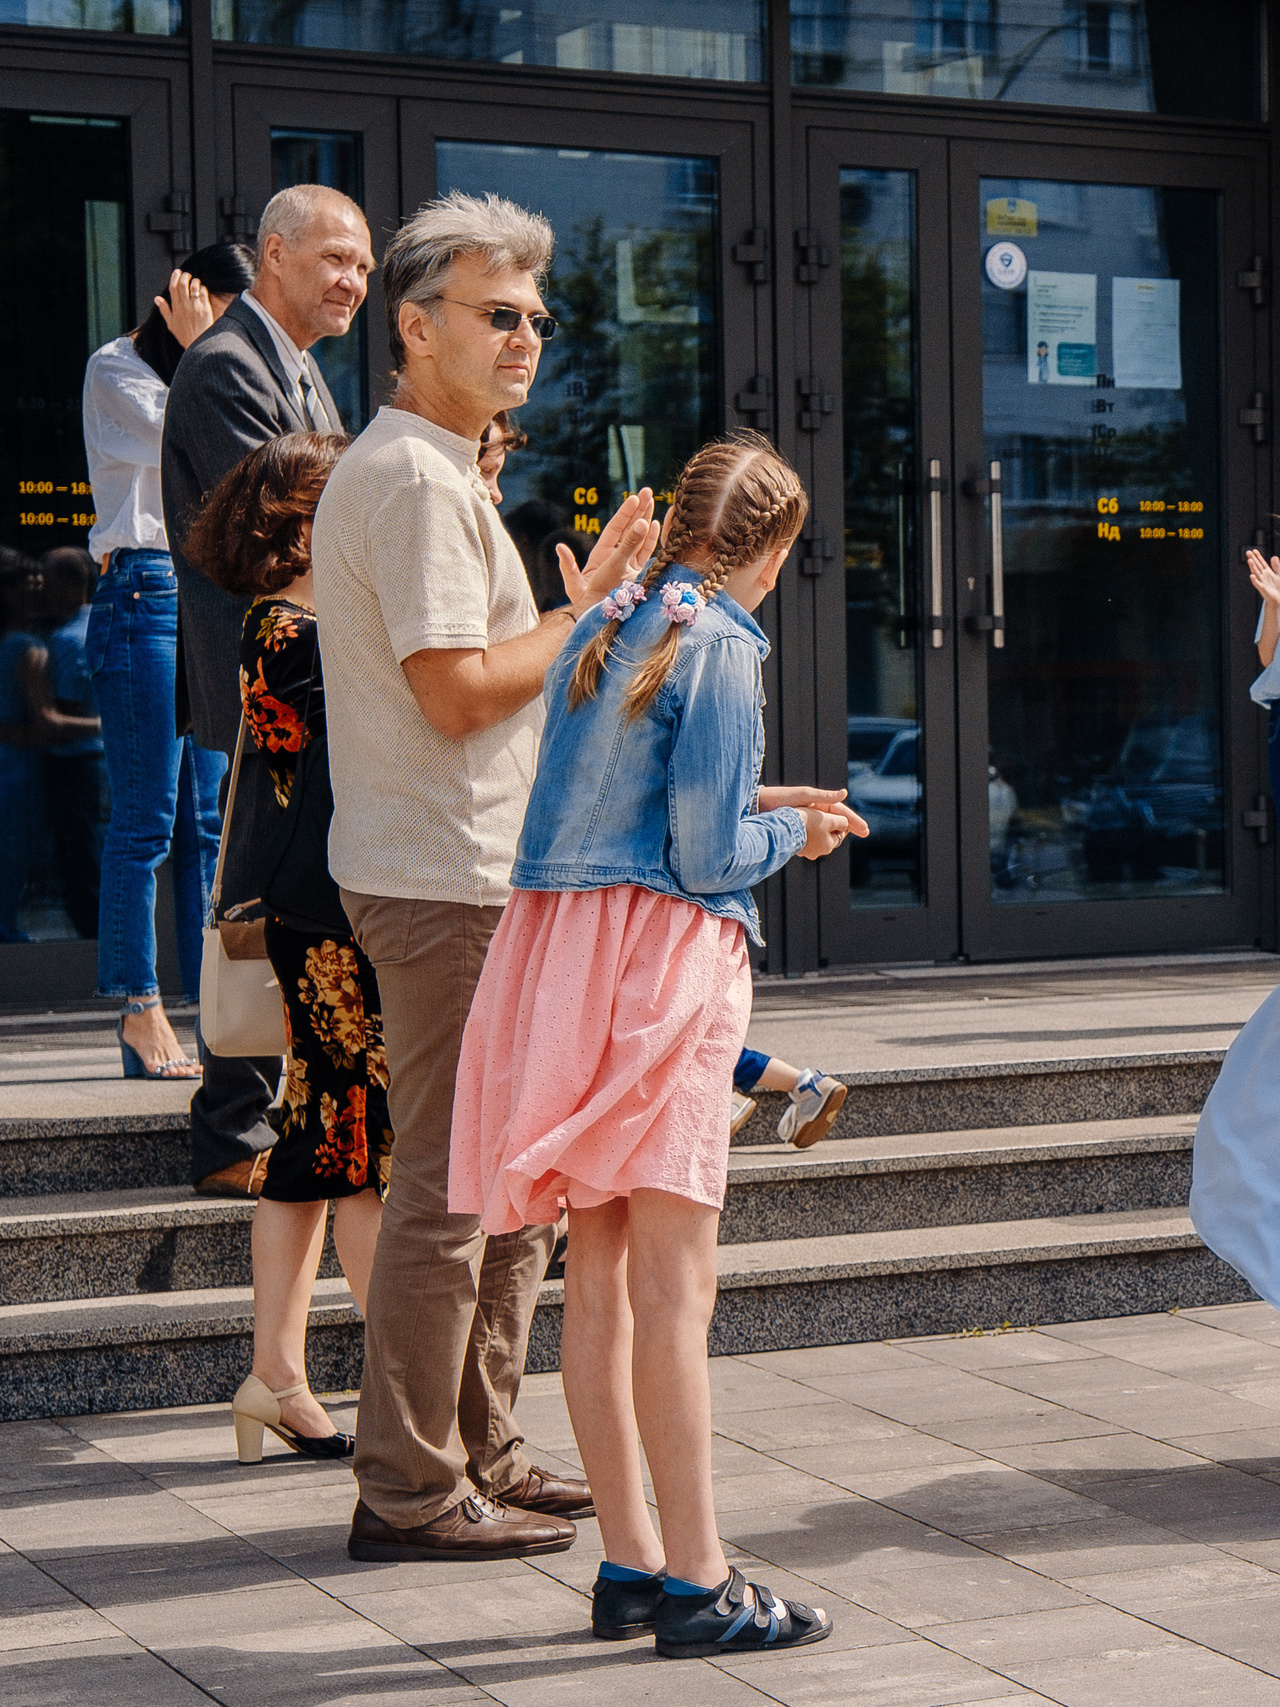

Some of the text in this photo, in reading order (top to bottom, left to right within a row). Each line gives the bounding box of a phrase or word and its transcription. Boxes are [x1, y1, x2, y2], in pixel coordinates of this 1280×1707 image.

[18, 480, 54, 495] 10:00
[70, 481, 93, 495] 18:
[573, 486, 599, 506] Сб
[1096, 497, 1120, 515] Сб
[1139, 500, 1166, 512] 10:00
[1177, 501, 1204, 513] 18:00
[19, 512, 55, 526] 10:00
[71, 513, 98, 527] 18:0
[573, 513, 601, 535] Нд
[1096, 521, 1122, 542] Нд
[1139, 527, 1166, 540] 10:00
[1177, 528, 1204, 540] 18:00
